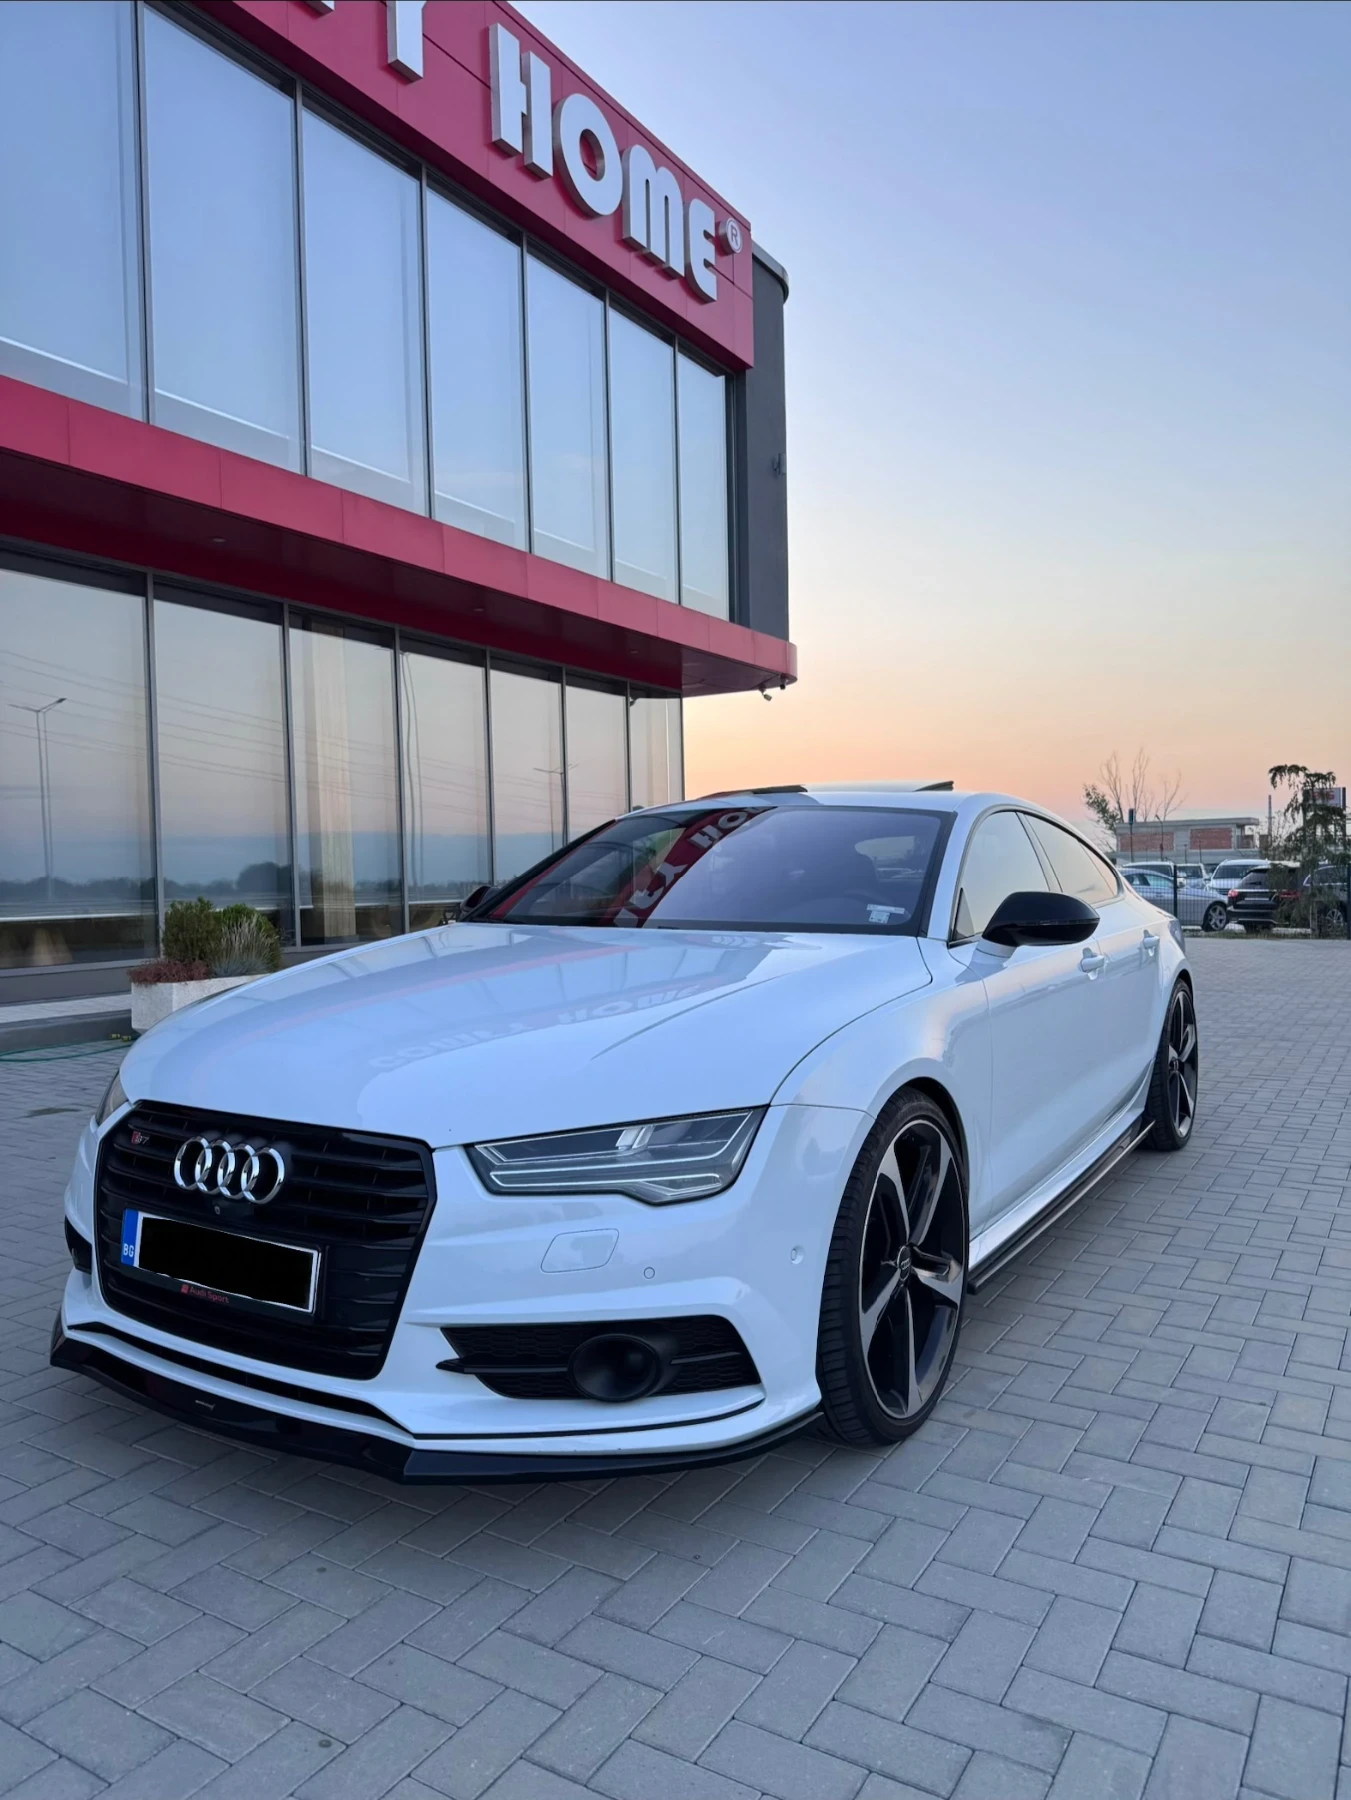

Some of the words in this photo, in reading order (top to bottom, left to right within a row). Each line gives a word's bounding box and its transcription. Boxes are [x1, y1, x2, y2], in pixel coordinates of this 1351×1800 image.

[489, 22, 718, 303] HOME
[123, 1243, 135, 1258] BG
[189, 1286, 207, 1297] Audi
[207, 1290, 230, 1304] Sport
